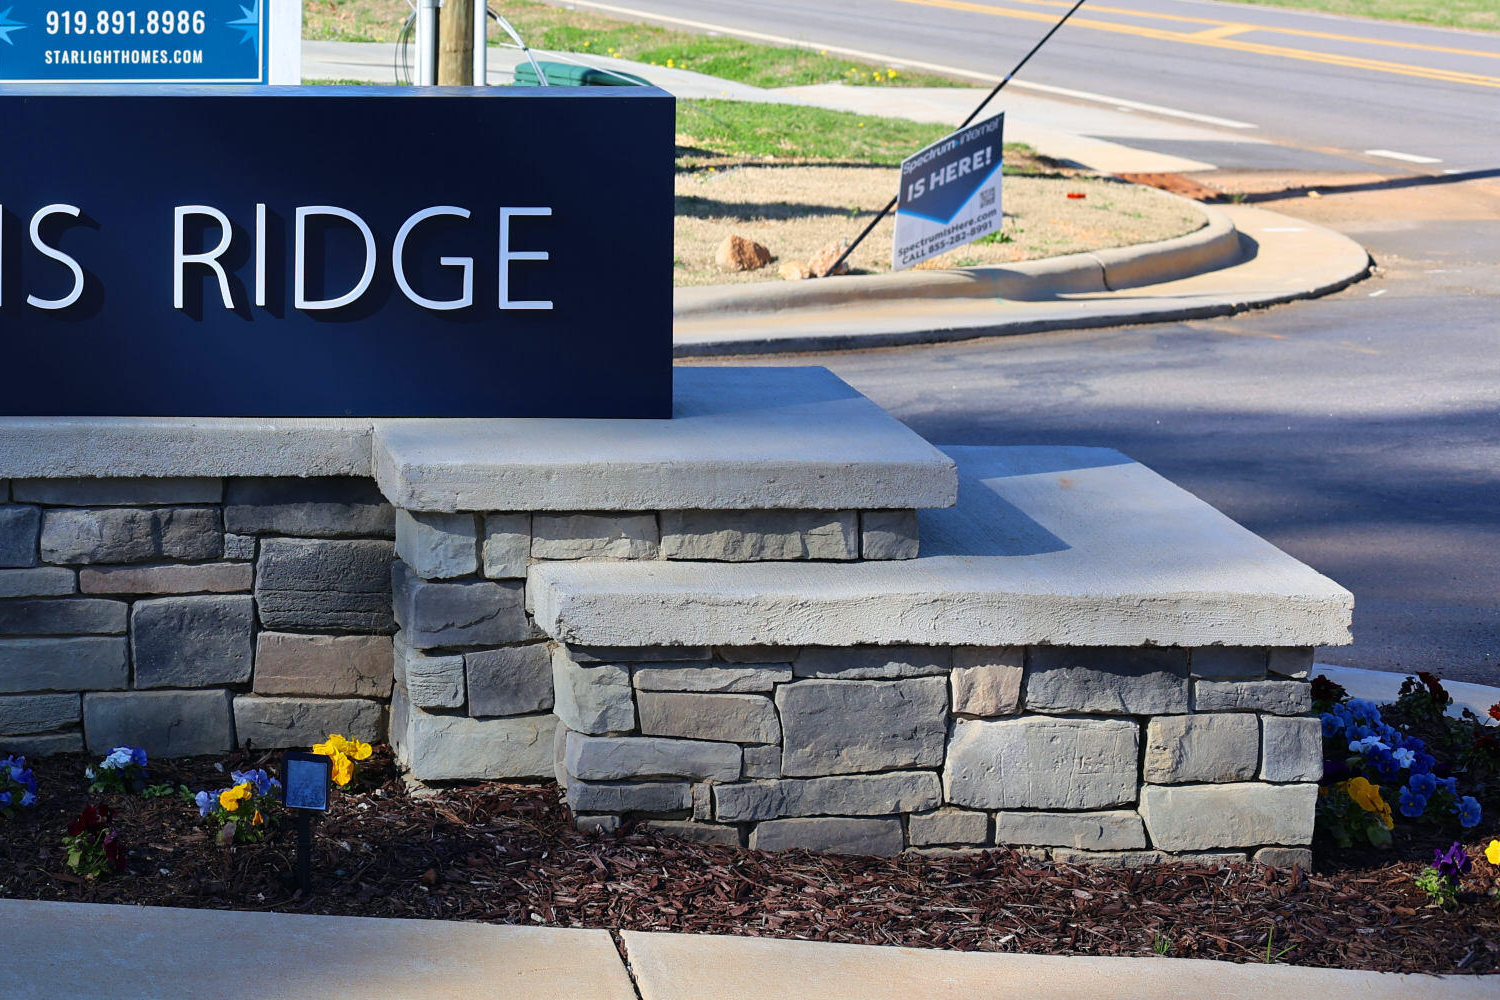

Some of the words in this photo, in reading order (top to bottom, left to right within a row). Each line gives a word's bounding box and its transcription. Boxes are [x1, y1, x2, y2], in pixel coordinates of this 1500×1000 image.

[46, 10, 206, 35] 919.891.8986
[44, 49, 203, 65] STARLIGHTHOMES.COM
[907, 178, 926, 203] IS
[929, 145, 992, 191] HERE!
[173, 202, 554, 311] RIDGE
[902, 249, 926, 265] CALL
